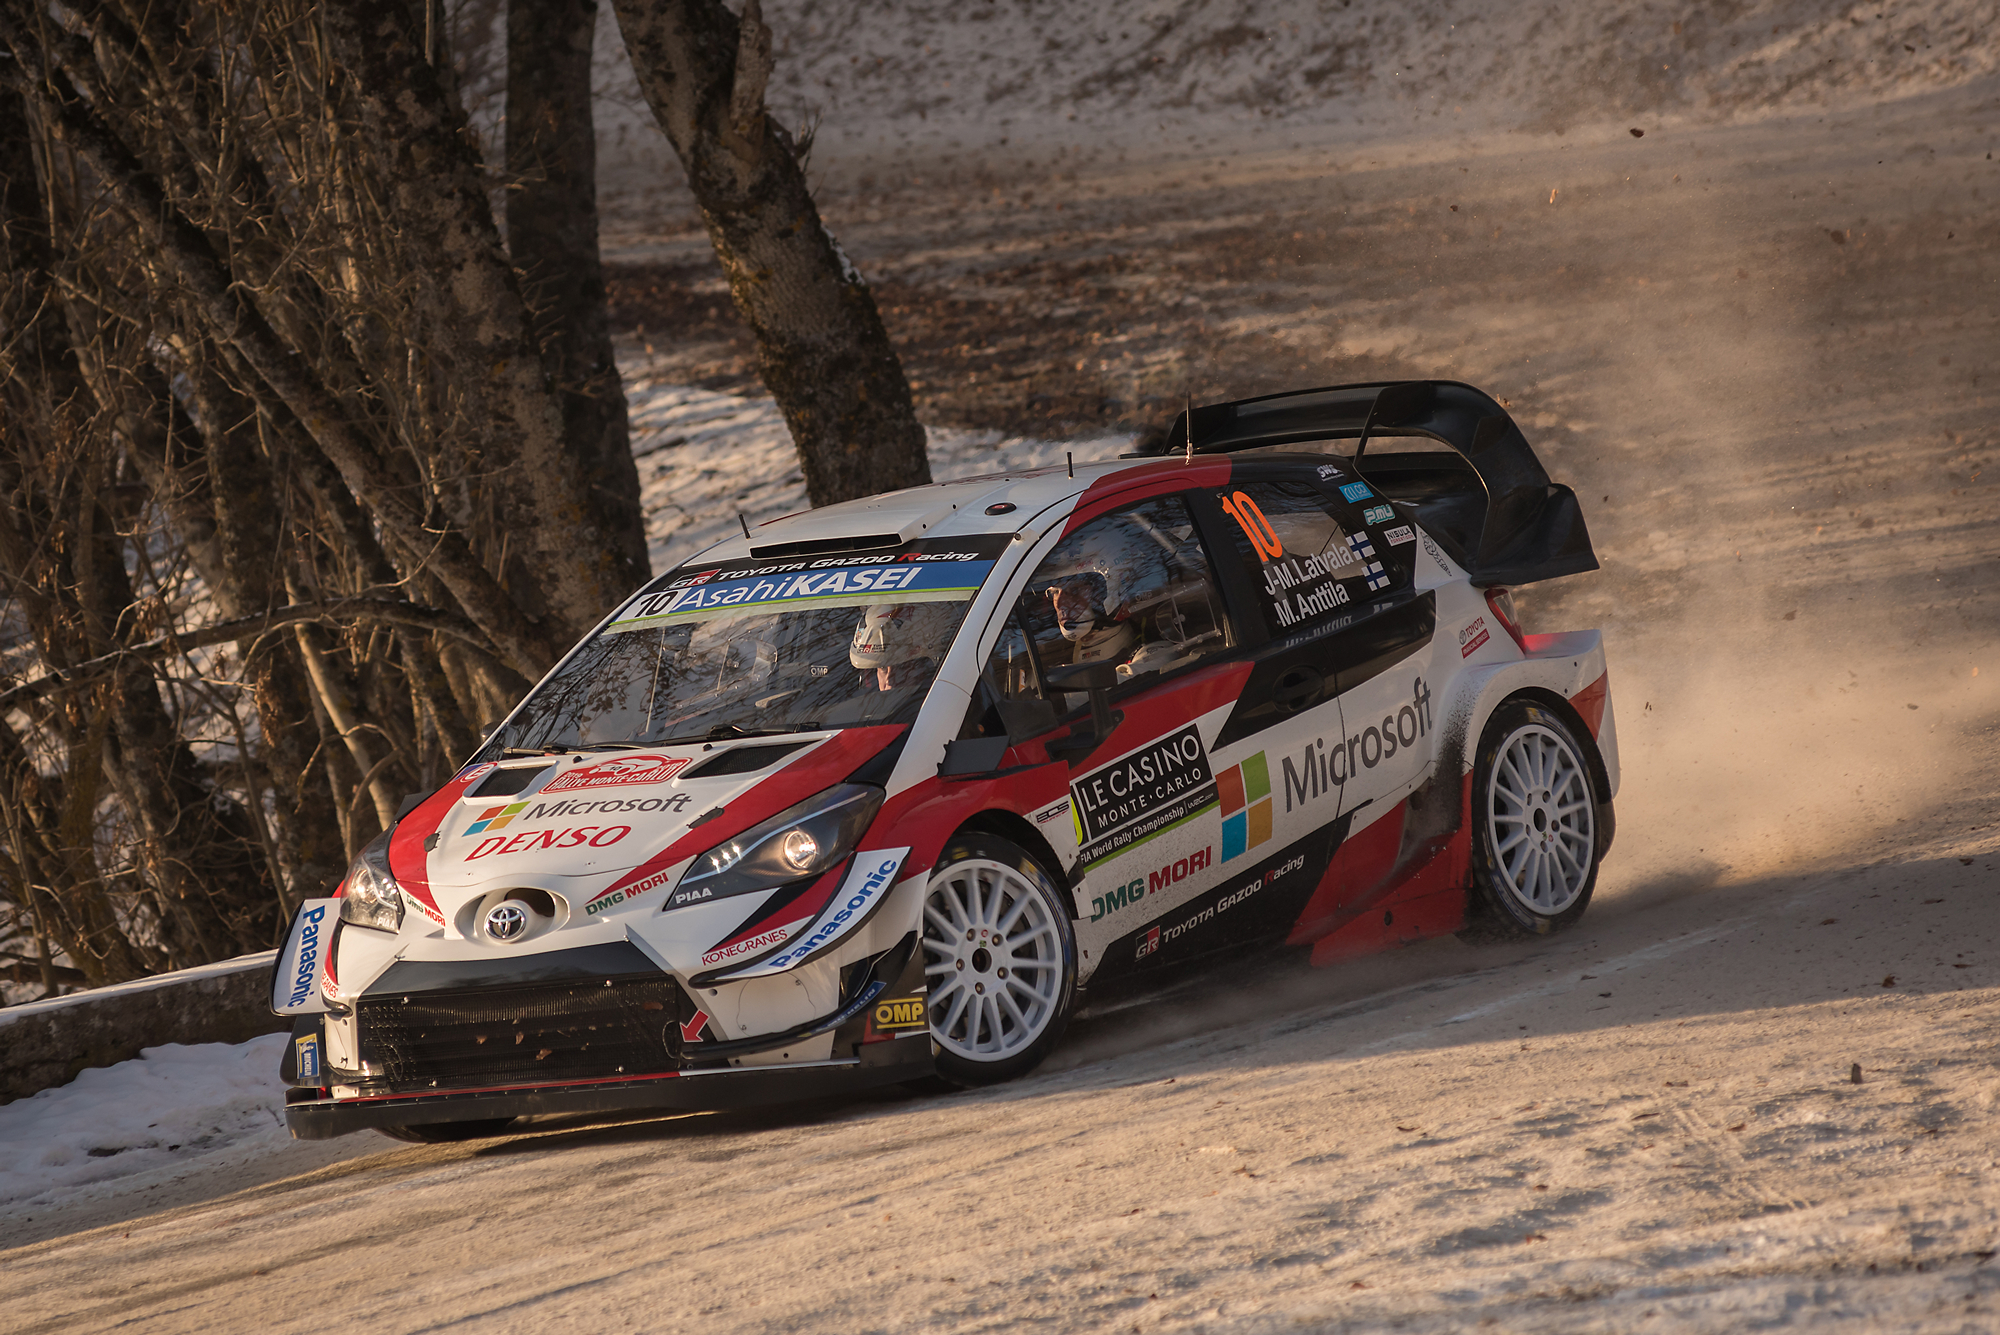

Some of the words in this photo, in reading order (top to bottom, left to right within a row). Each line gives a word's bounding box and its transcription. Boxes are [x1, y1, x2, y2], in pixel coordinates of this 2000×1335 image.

[1221, 491, 1283, 562] 10
[1386, 527, 1411, 540] NISULA
[719, 562, 806, 580] TOYOTA
[809, 554, 896, 568] GAZOO
[897, 551, 980, 562] Racing
[1264, 544, 1355, 596] J-M.Latvala
[636, 590, 680, 618] 10
[1273, 580, 1351, 628] M.Anttila
[1466, 616, 1486, 638] TOYOTA
[810, 666, 829, 677] OMP
[1282, 676, 1432, 813] Microsoft
[546, 776, 589, 791] RALLYE
[1081, 780, 1109, 812] LE
[1109, 734, 1200, 797] CASINO
[523, 793, 692, 820] Microsoft
[464, 825, 632, 862] DENSO
[1080, 851, 1092, 864] FIA
[1092, 839, 1113, 859] World
[1113, 829, 1132, 848] Rally
[1133, 806, 1185, 838] Championship
[584, 892, 625, 916] DMG
[623, 872, 670, 899] MORI
[675, 886, 713, 904] PIAA
[1091, 878, 1146, 923] DMG
[1148, 846, 1213, 895] MORI
[1162, 907, 1216, 943] TOYOTA
[1217, 879, 1262, 914] GAZOO
[1264, 854, 1306, 886] Racing
[377, 917, 396, 930] PIAA
[424, 907, 446, 927] MORI
[768, 859, 898, 968] Panasonic
[287, 904, 326, 1008] Panasonic
[701, 929, 788, 966] KONECRANES
[875, 1002, 924, 1023] OMP
